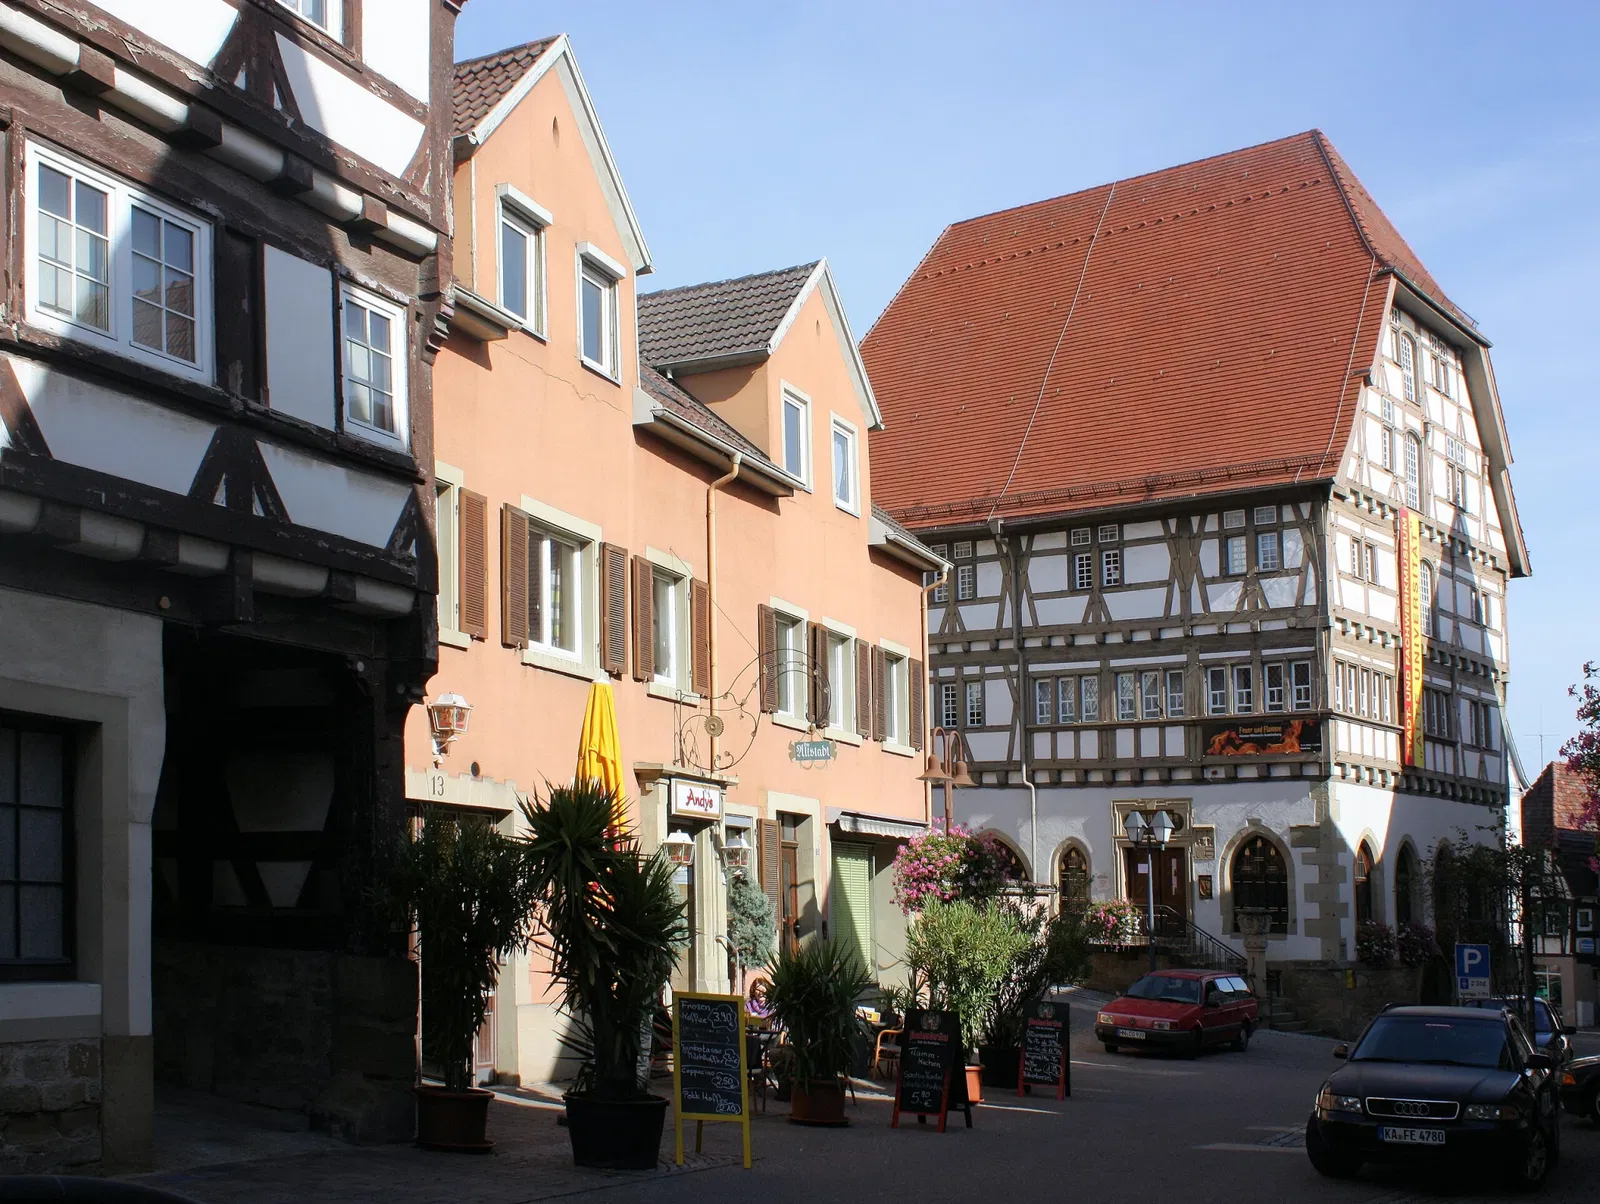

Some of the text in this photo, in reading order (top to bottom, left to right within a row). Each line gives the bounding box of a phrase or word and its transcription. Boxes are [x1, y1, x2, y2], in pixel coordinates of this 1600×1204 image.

[1402, 516, 1411, 666] FACHWERKMUSEUM
[1239, 726, 1252, 734] Feuer
[1263, 725, 1282, 733] Flamme
[795, 744, 830, 758] Altstadt
[431, 775, 445, 797] 13
[1464, 949, 1482, 973] P
[680, 1000, 711, 1011] Frozen
[1384, 1128, 1444, 1142] KA FE 4780
